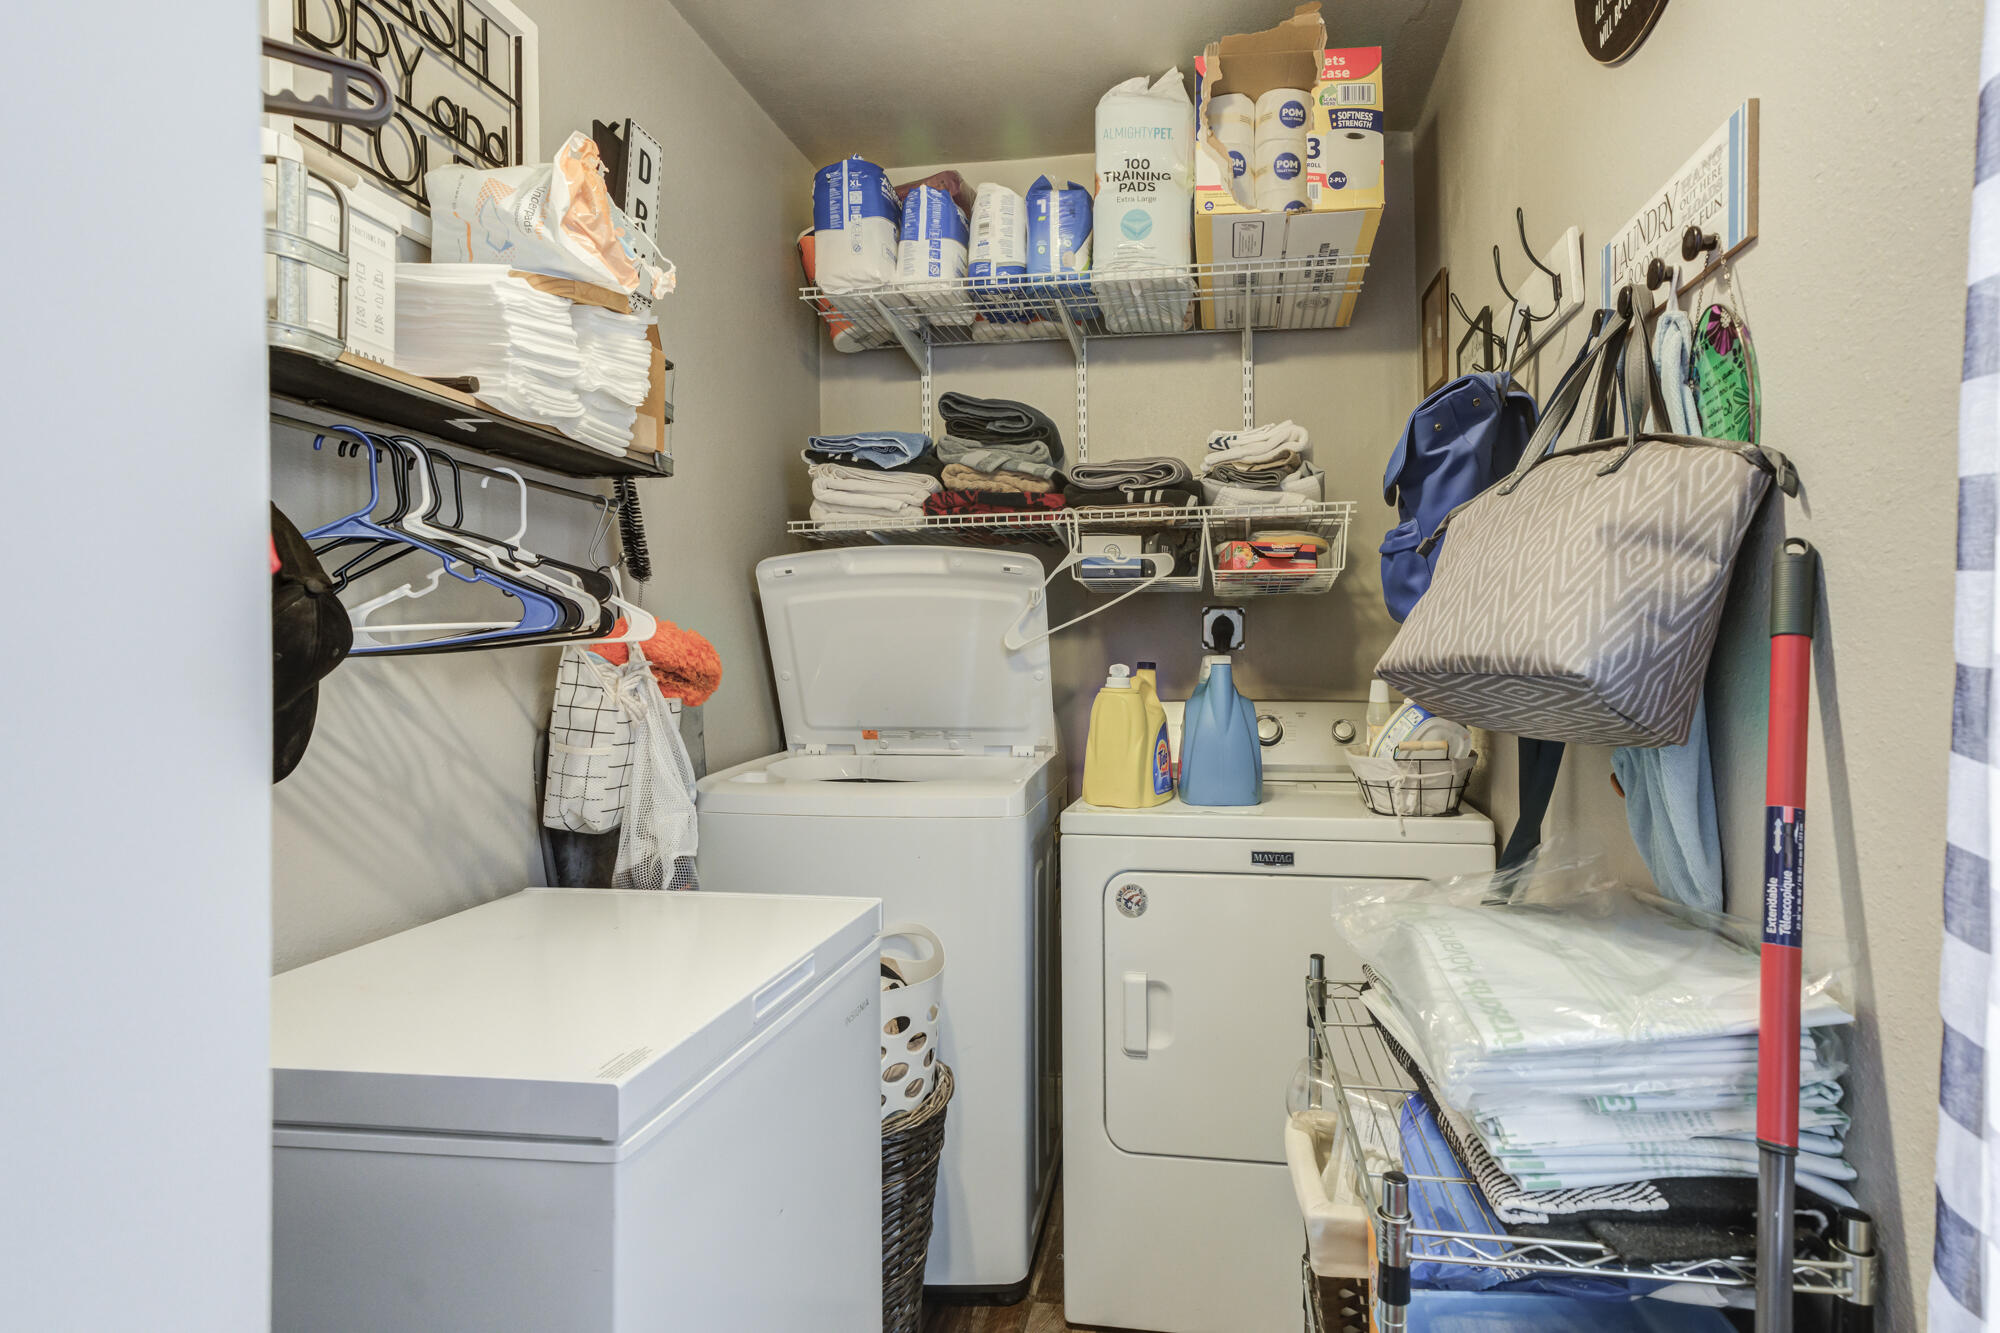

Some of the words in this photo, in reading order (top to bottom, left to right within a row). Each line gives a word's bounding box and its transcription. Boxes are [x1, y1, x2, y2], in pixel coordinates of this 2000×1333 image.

[1600, 14, 1613, 48] WILL
[1325, 56, 1346, 66] ets
[1282, 108, 1304, 118] POM
[1337, 111, 1374, 121] SOFTNESS
[1337, 120, 1372, 129] STRENGTH
[432, 95, 507, 167] and
[1124, 158, 1151, 170] 100
[1276, 160, 1298, 169] POM
[1103, 170, 1172, 182] TRAINING
[849, 179, 862, 187] XL
[1118, 182, 1156, 193] PADS
[1679, 187, 1697, 211] OUT
[1699, 162, 1722, 194] HERE
[1116, 195, 1135, 204] Extra
[1137, 196, 1157, 205] Large
[1699, 190, 1723, 226] FUN
[1612, 180, 1679, 286] LAUNDRY
[1253, 853, 1293, 863] MAYTAG
[1766, 876, 1779, 935] Extendable
[1779, 869, 1796, 937] Télescopique
